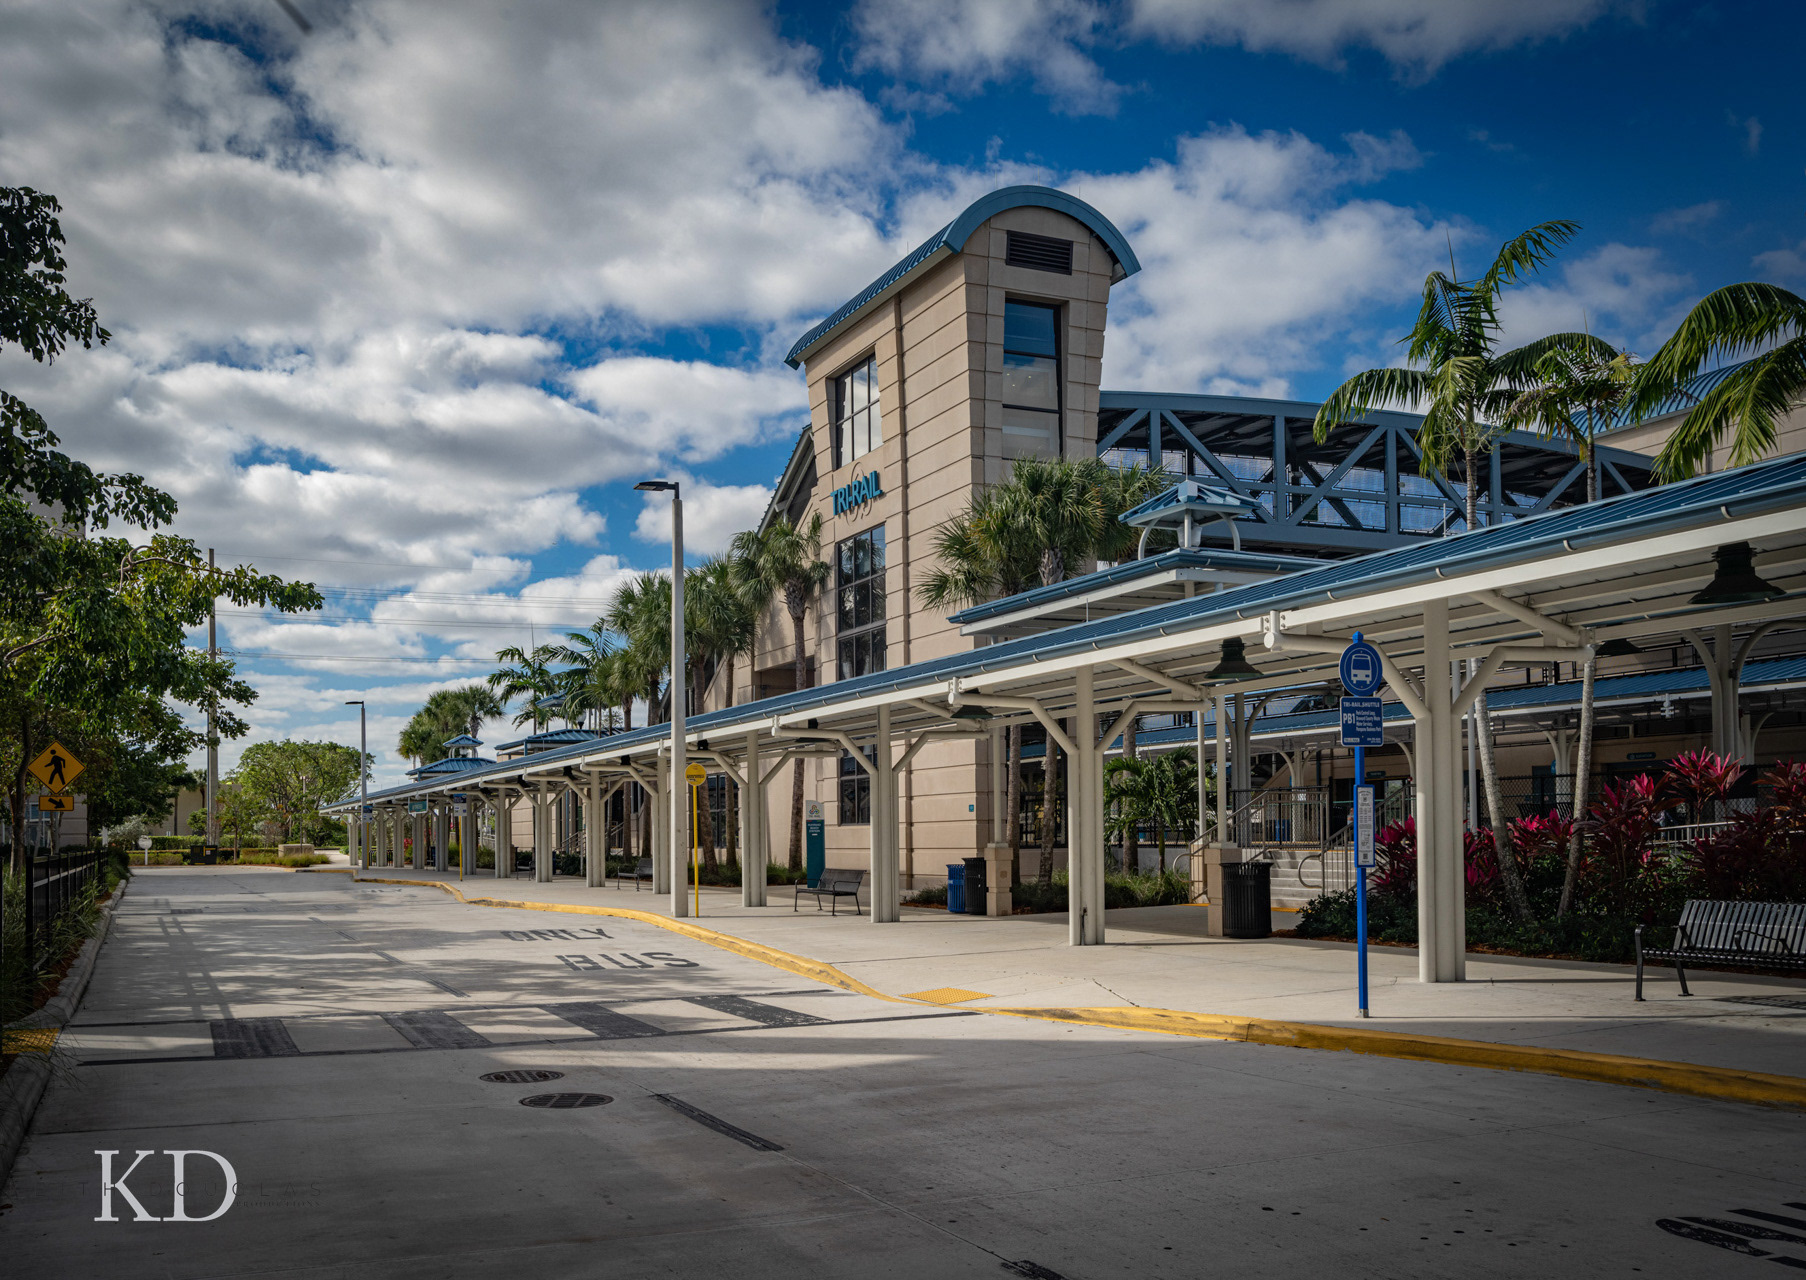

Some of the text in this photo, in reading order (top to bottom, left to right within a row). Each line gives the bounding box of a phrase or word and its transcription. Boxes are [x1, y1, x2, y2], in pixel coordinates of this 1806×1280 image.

[830, 470, 882, 516] TRI-RAIL
[1343, 713, 1356, 724] PB1
[501, 928, 615, 942] ONLY
[554, 951, 700, 972] BUS
